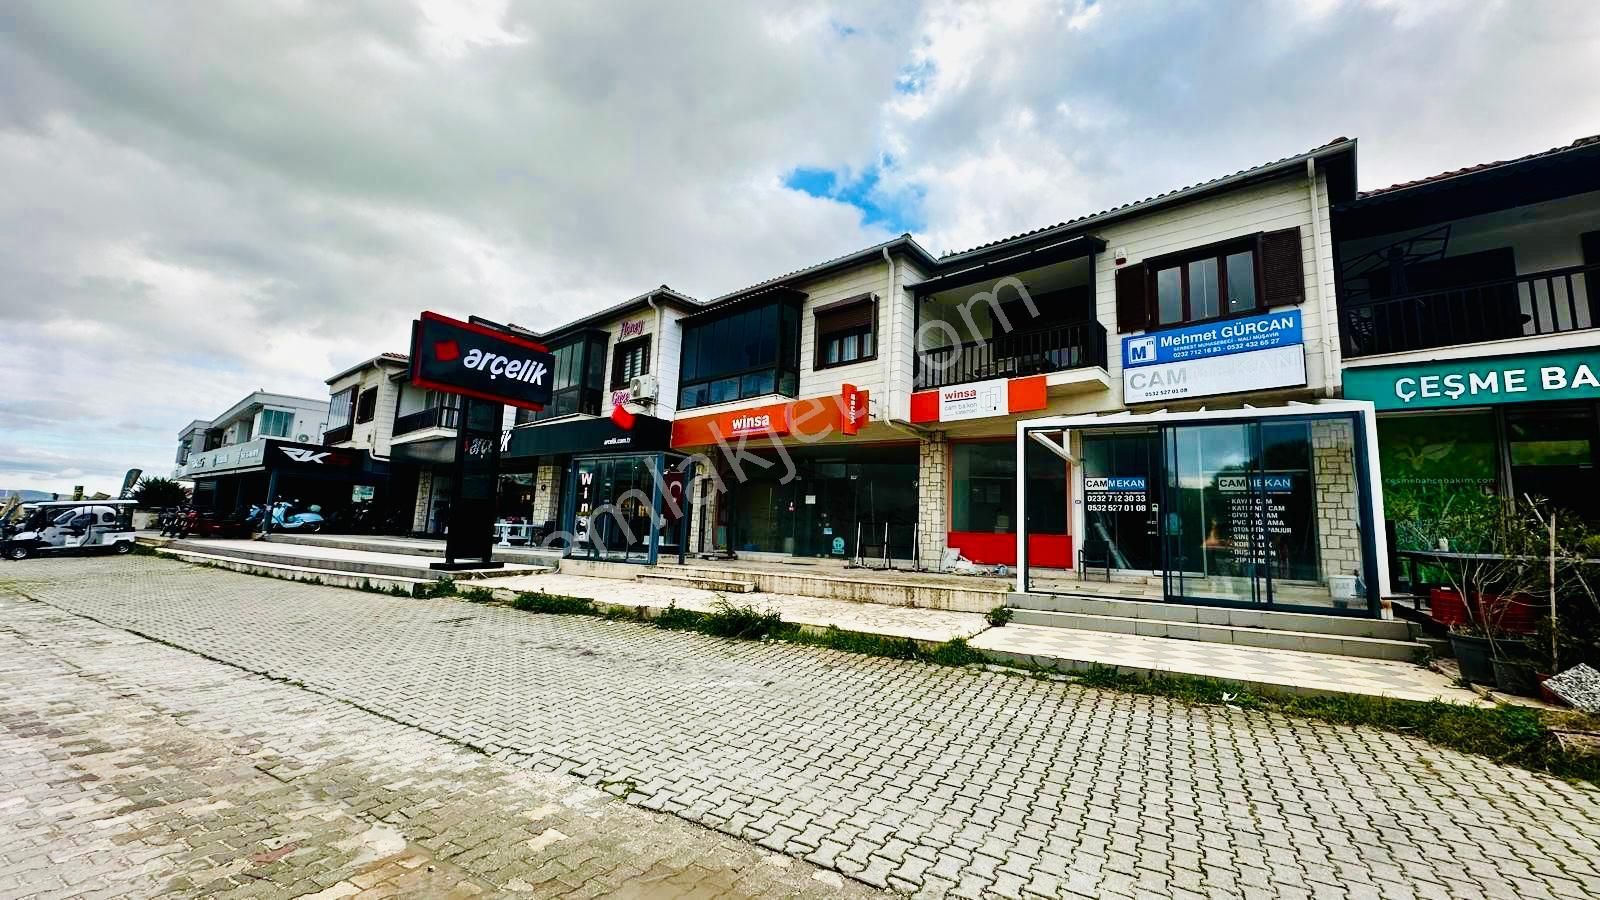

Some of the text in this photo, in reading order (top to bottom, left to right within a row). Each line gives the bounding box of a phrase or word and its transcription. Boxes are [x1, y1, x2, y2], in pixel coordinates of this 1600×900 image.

[1161, 316, 1294, 348] Mehmet GÜRCAN
[463, 348, 547, 386] arçelik
[1129, 367, 1187, 390] CAM
[945, 389, 977, 400] winsa
[1395, 369, 1528, 402] ÇEŞME
[733, 415, 770, 430] winsa
